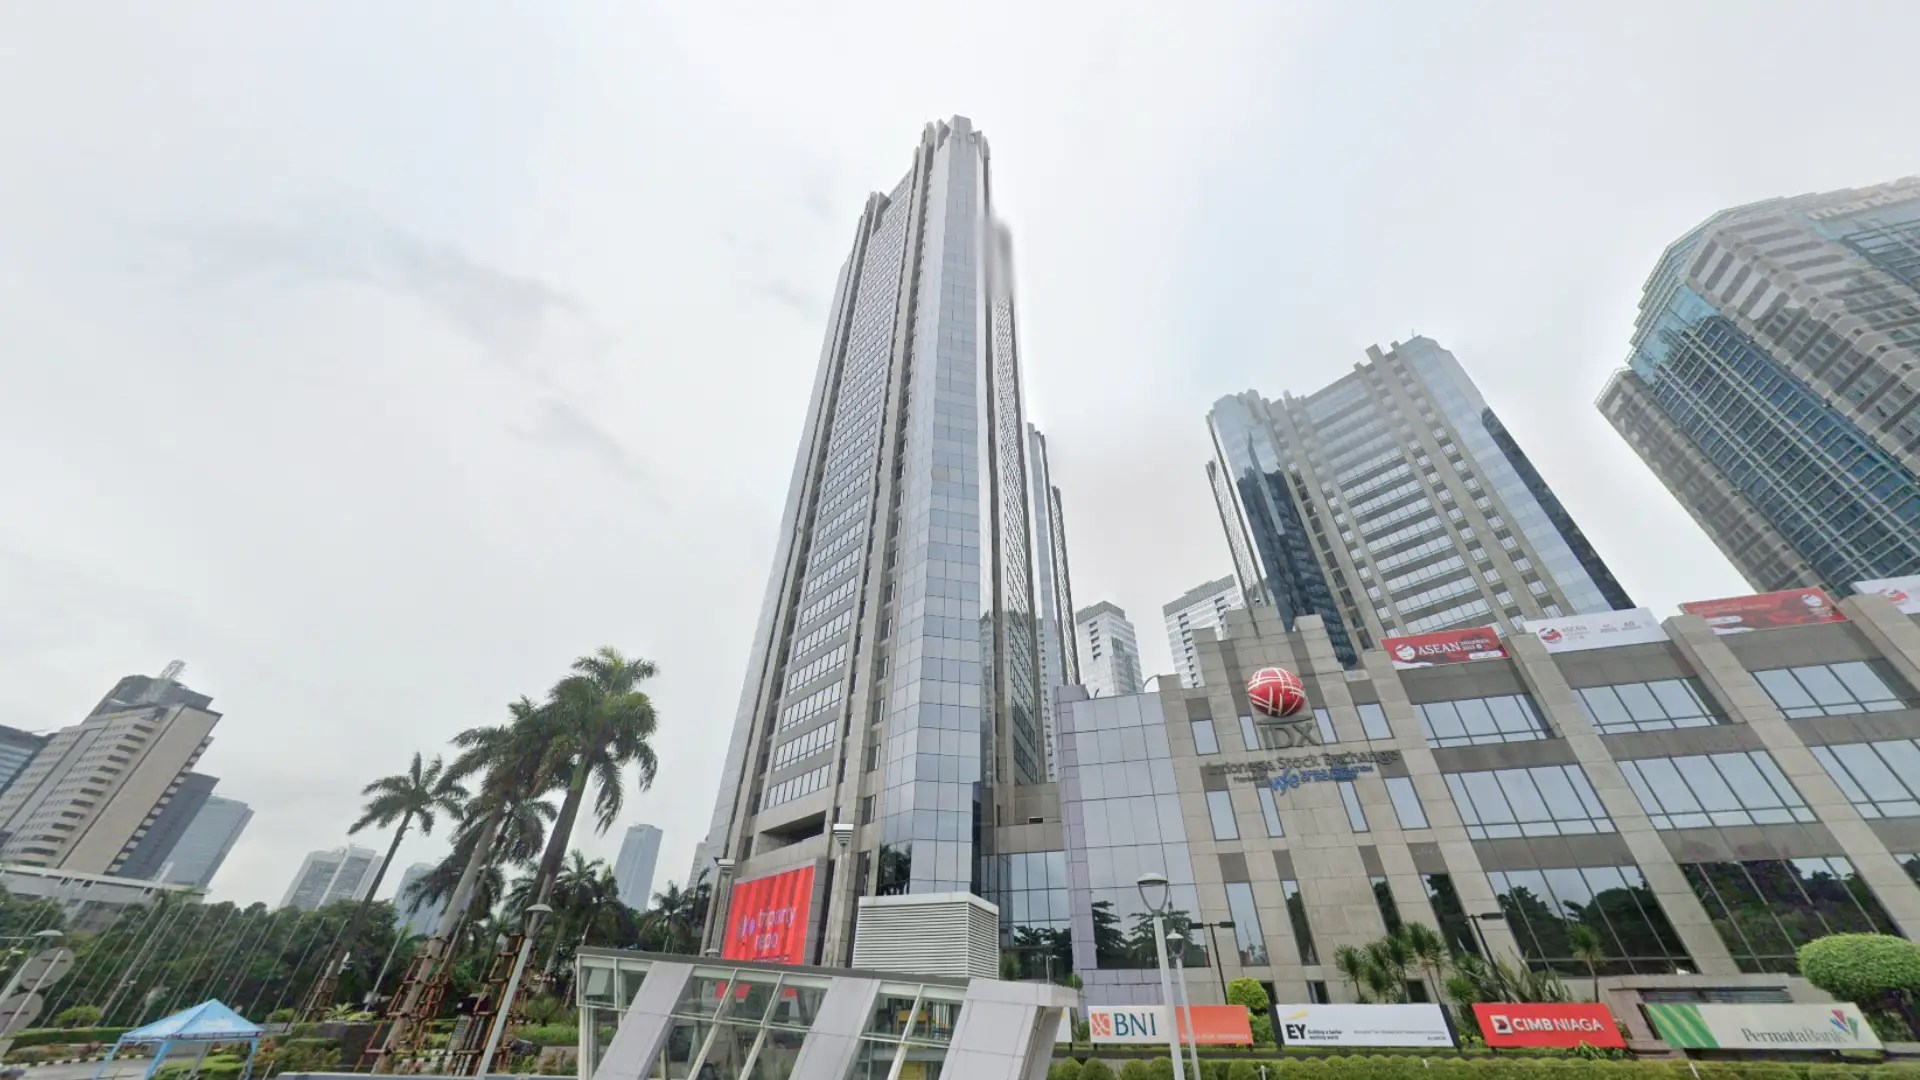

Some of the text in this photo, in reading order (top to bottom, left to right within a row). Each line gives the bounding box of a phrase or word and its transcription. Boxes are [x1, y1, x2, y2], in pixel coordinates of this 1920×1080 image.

[1418, 642, 1461, 656] ASEAN
[1261, 722, 1321, 750] IDX
[1278, 754, 1320, 771] Stock
[1114, 1013, 1157, 1036] BNI
[1286, 1024, 1306, 1039] EY
[1512, 1017, 1604, 1033] CIMB NIAGA
[1741, 1027, 1847, 1045] PermataBank
